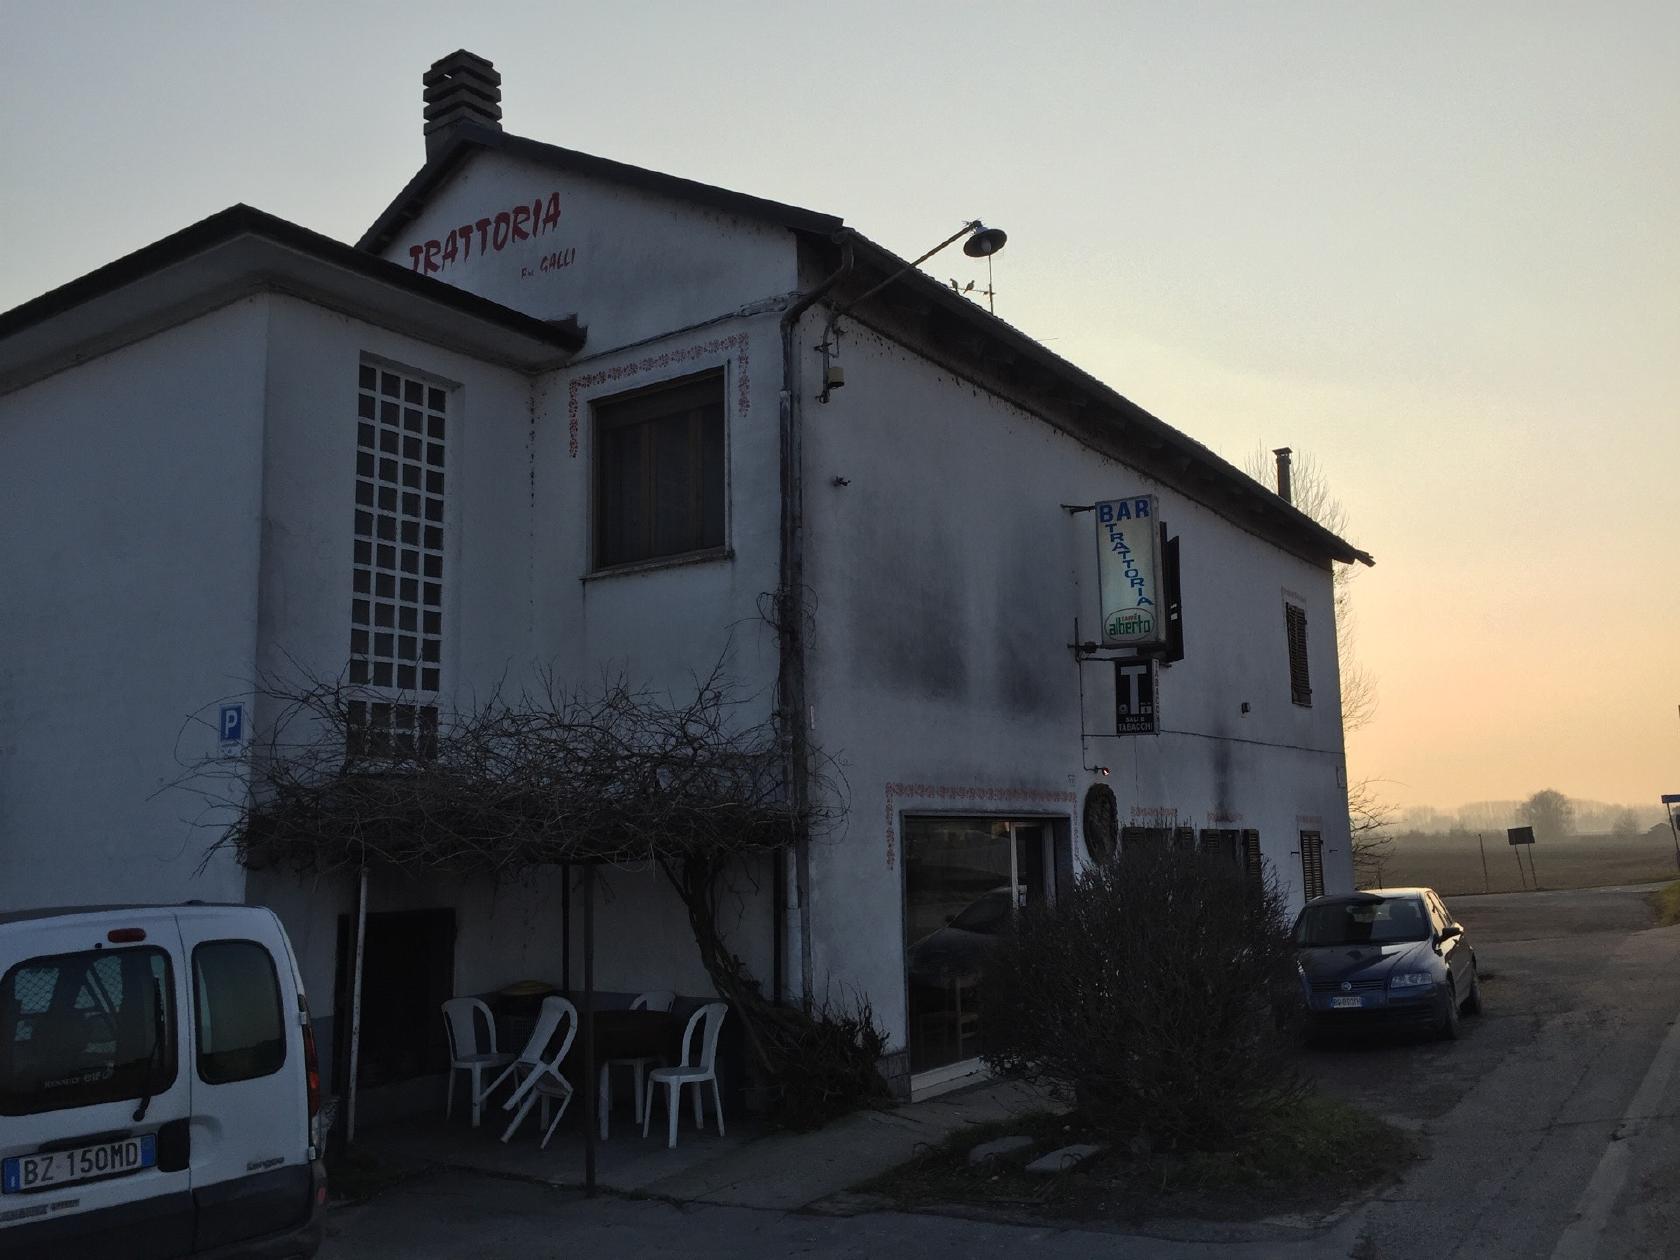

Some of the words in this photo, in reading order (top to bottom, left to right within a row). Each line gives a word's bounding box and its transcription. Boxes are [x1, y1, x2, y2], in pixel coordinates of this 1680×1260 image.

[409, 192, 562, 275] TRATTORIA
[540, 247, 576, 272] GALLI
[1099, 500, 1150, 523] BAR
[1104, 522, 1155, 607] TRATTORIA
[1109, 614, 1151, 636] alberto
[1120, 664, 1148, 715] T
[225, 709, 238, 738] P
[24, 1156, 55, 1185] BZ
[66, 1142, 139, 1177] 150MD
